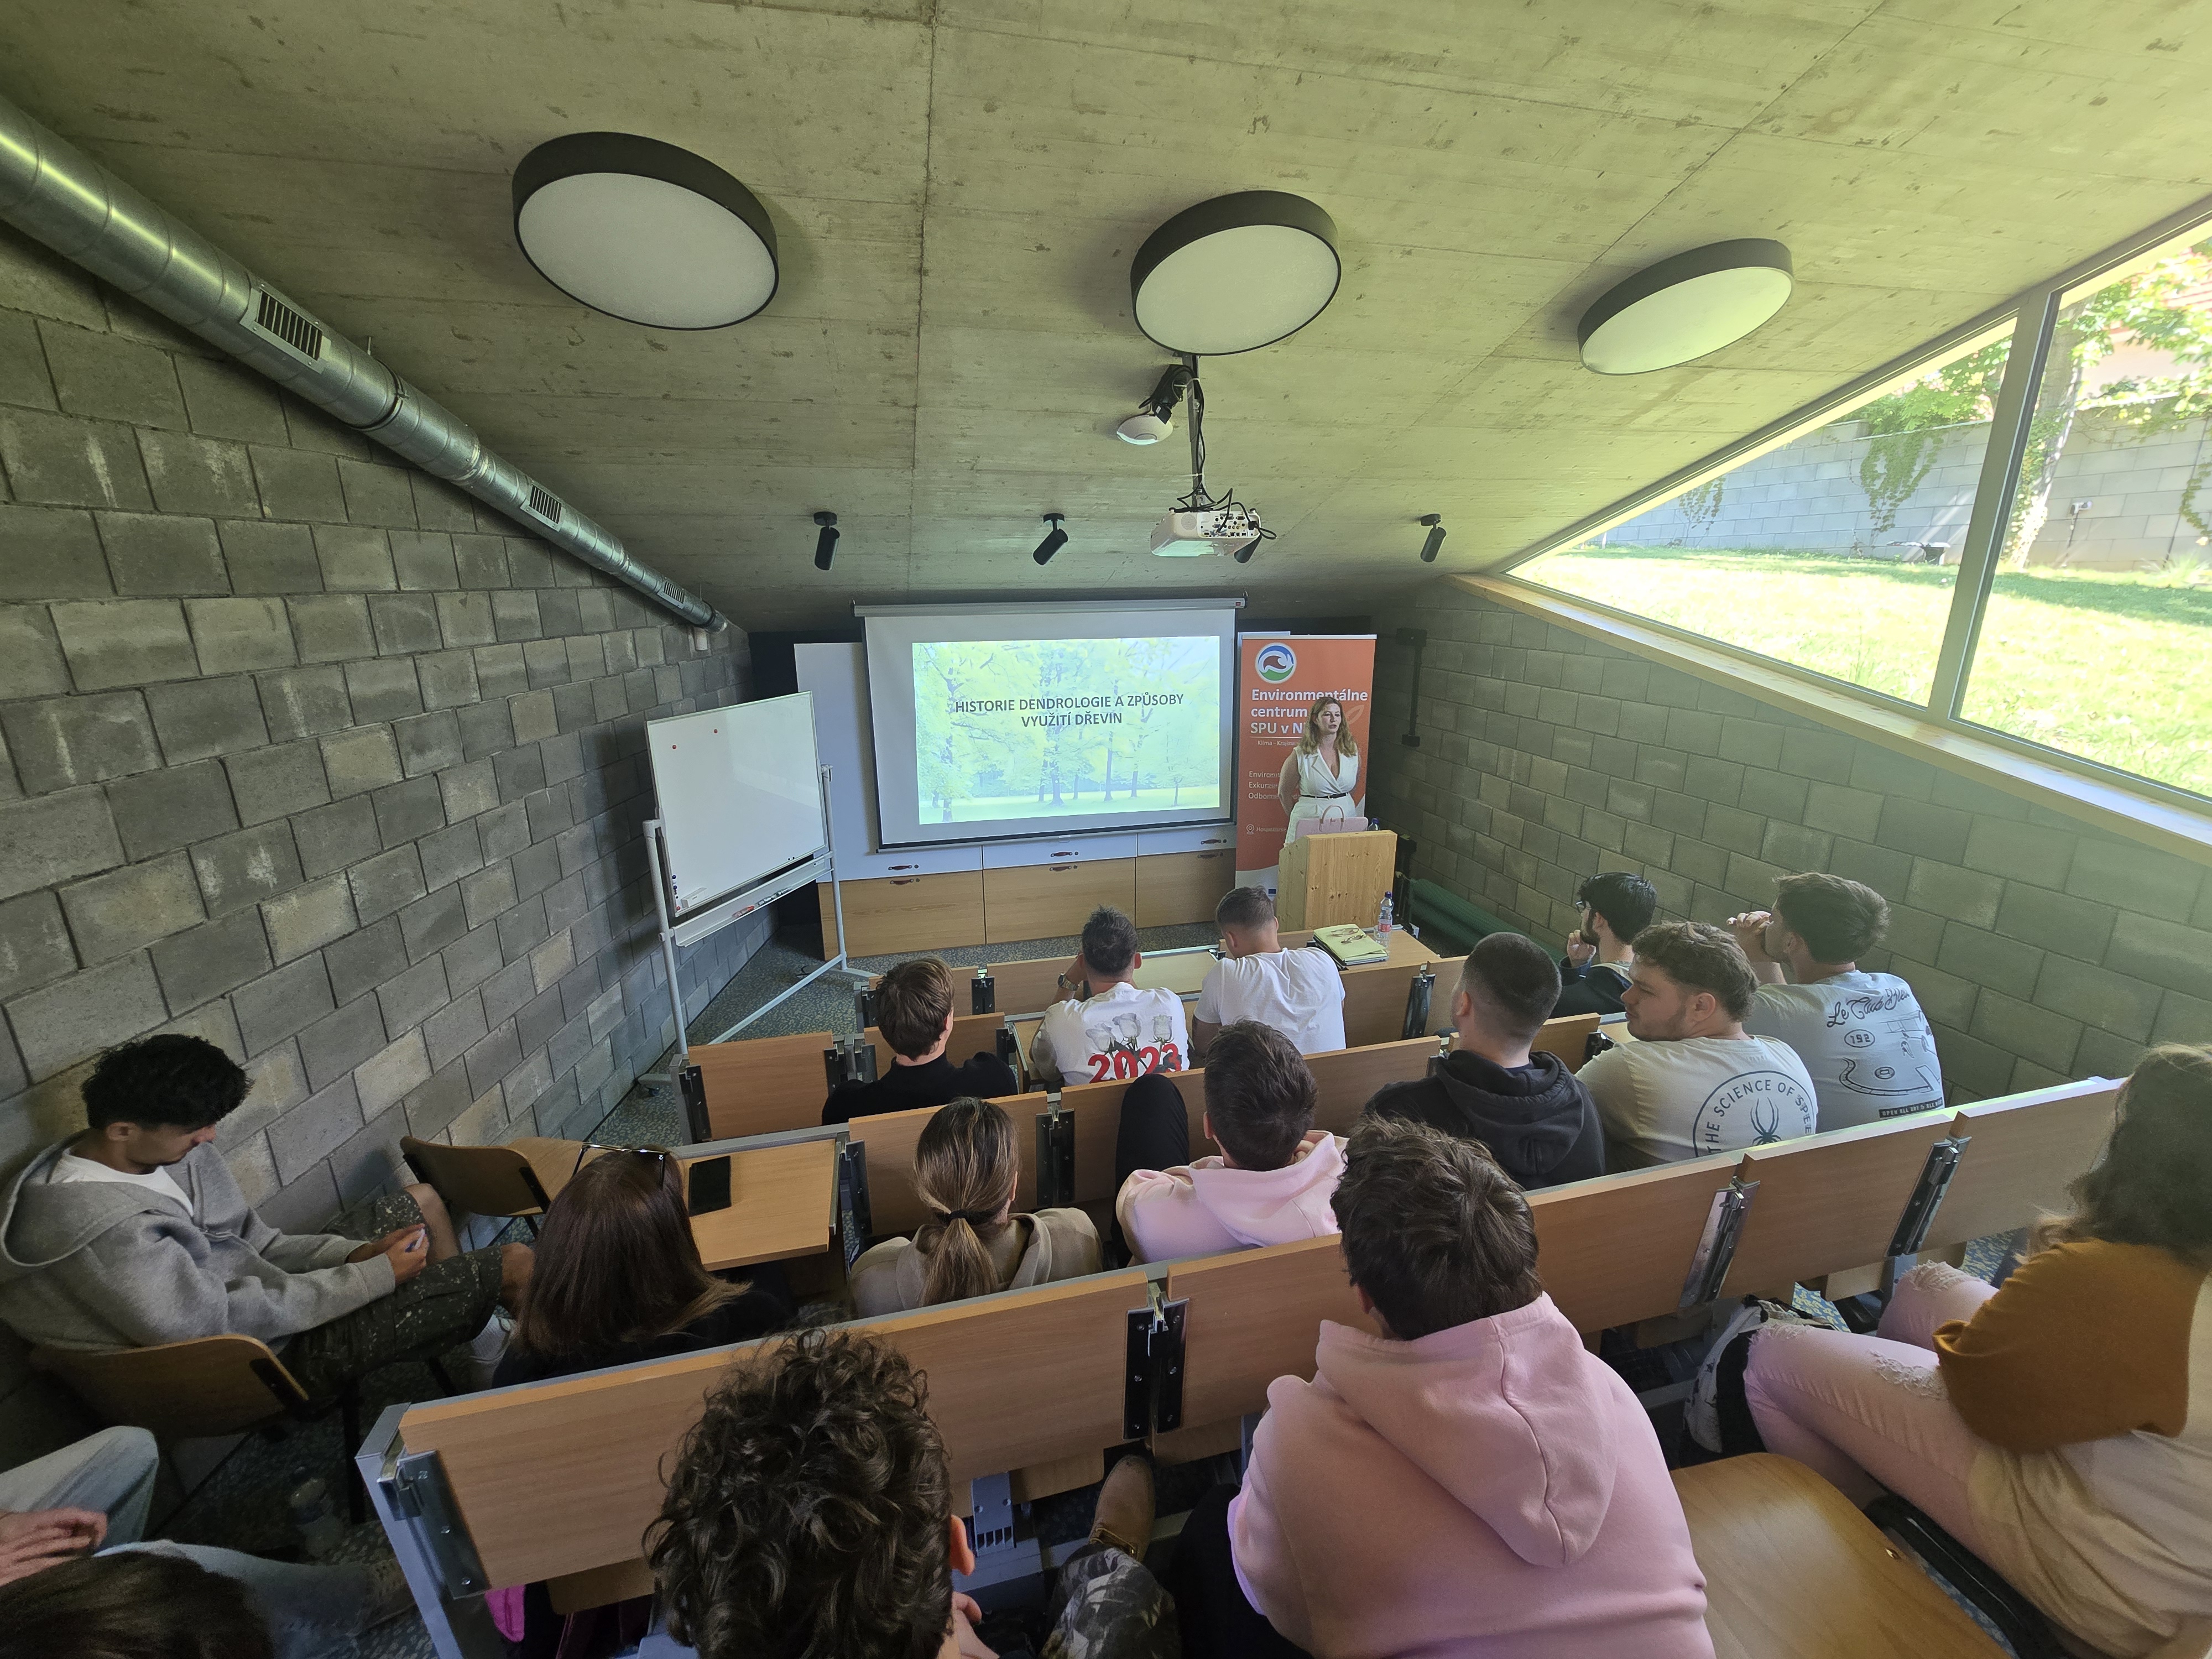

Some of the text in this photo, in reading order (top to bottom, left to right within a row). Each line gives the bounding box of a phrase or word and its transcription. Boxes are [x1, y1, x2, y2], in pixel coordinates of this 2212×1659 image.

[956, 692, 1184, 713] HISTORIE DENDROLOGIE A ZPŮSOBY
[1252, 689, 1368, 701] Environmentálne
[1021, 711, 1122, 727] VYUŽITÍ DŘEVIN
[1251, 707, 1308, 718] centrum
[1250, 722, 1277, 734] SPU
[1281, 725, 1289, 734] v
[1827, 1001, 1849, 1028] Le
[1088, 1044, 1182, 1084] 2023
[1705, 1079, 1812, 1154] THE SCIENCE OF SPEE
